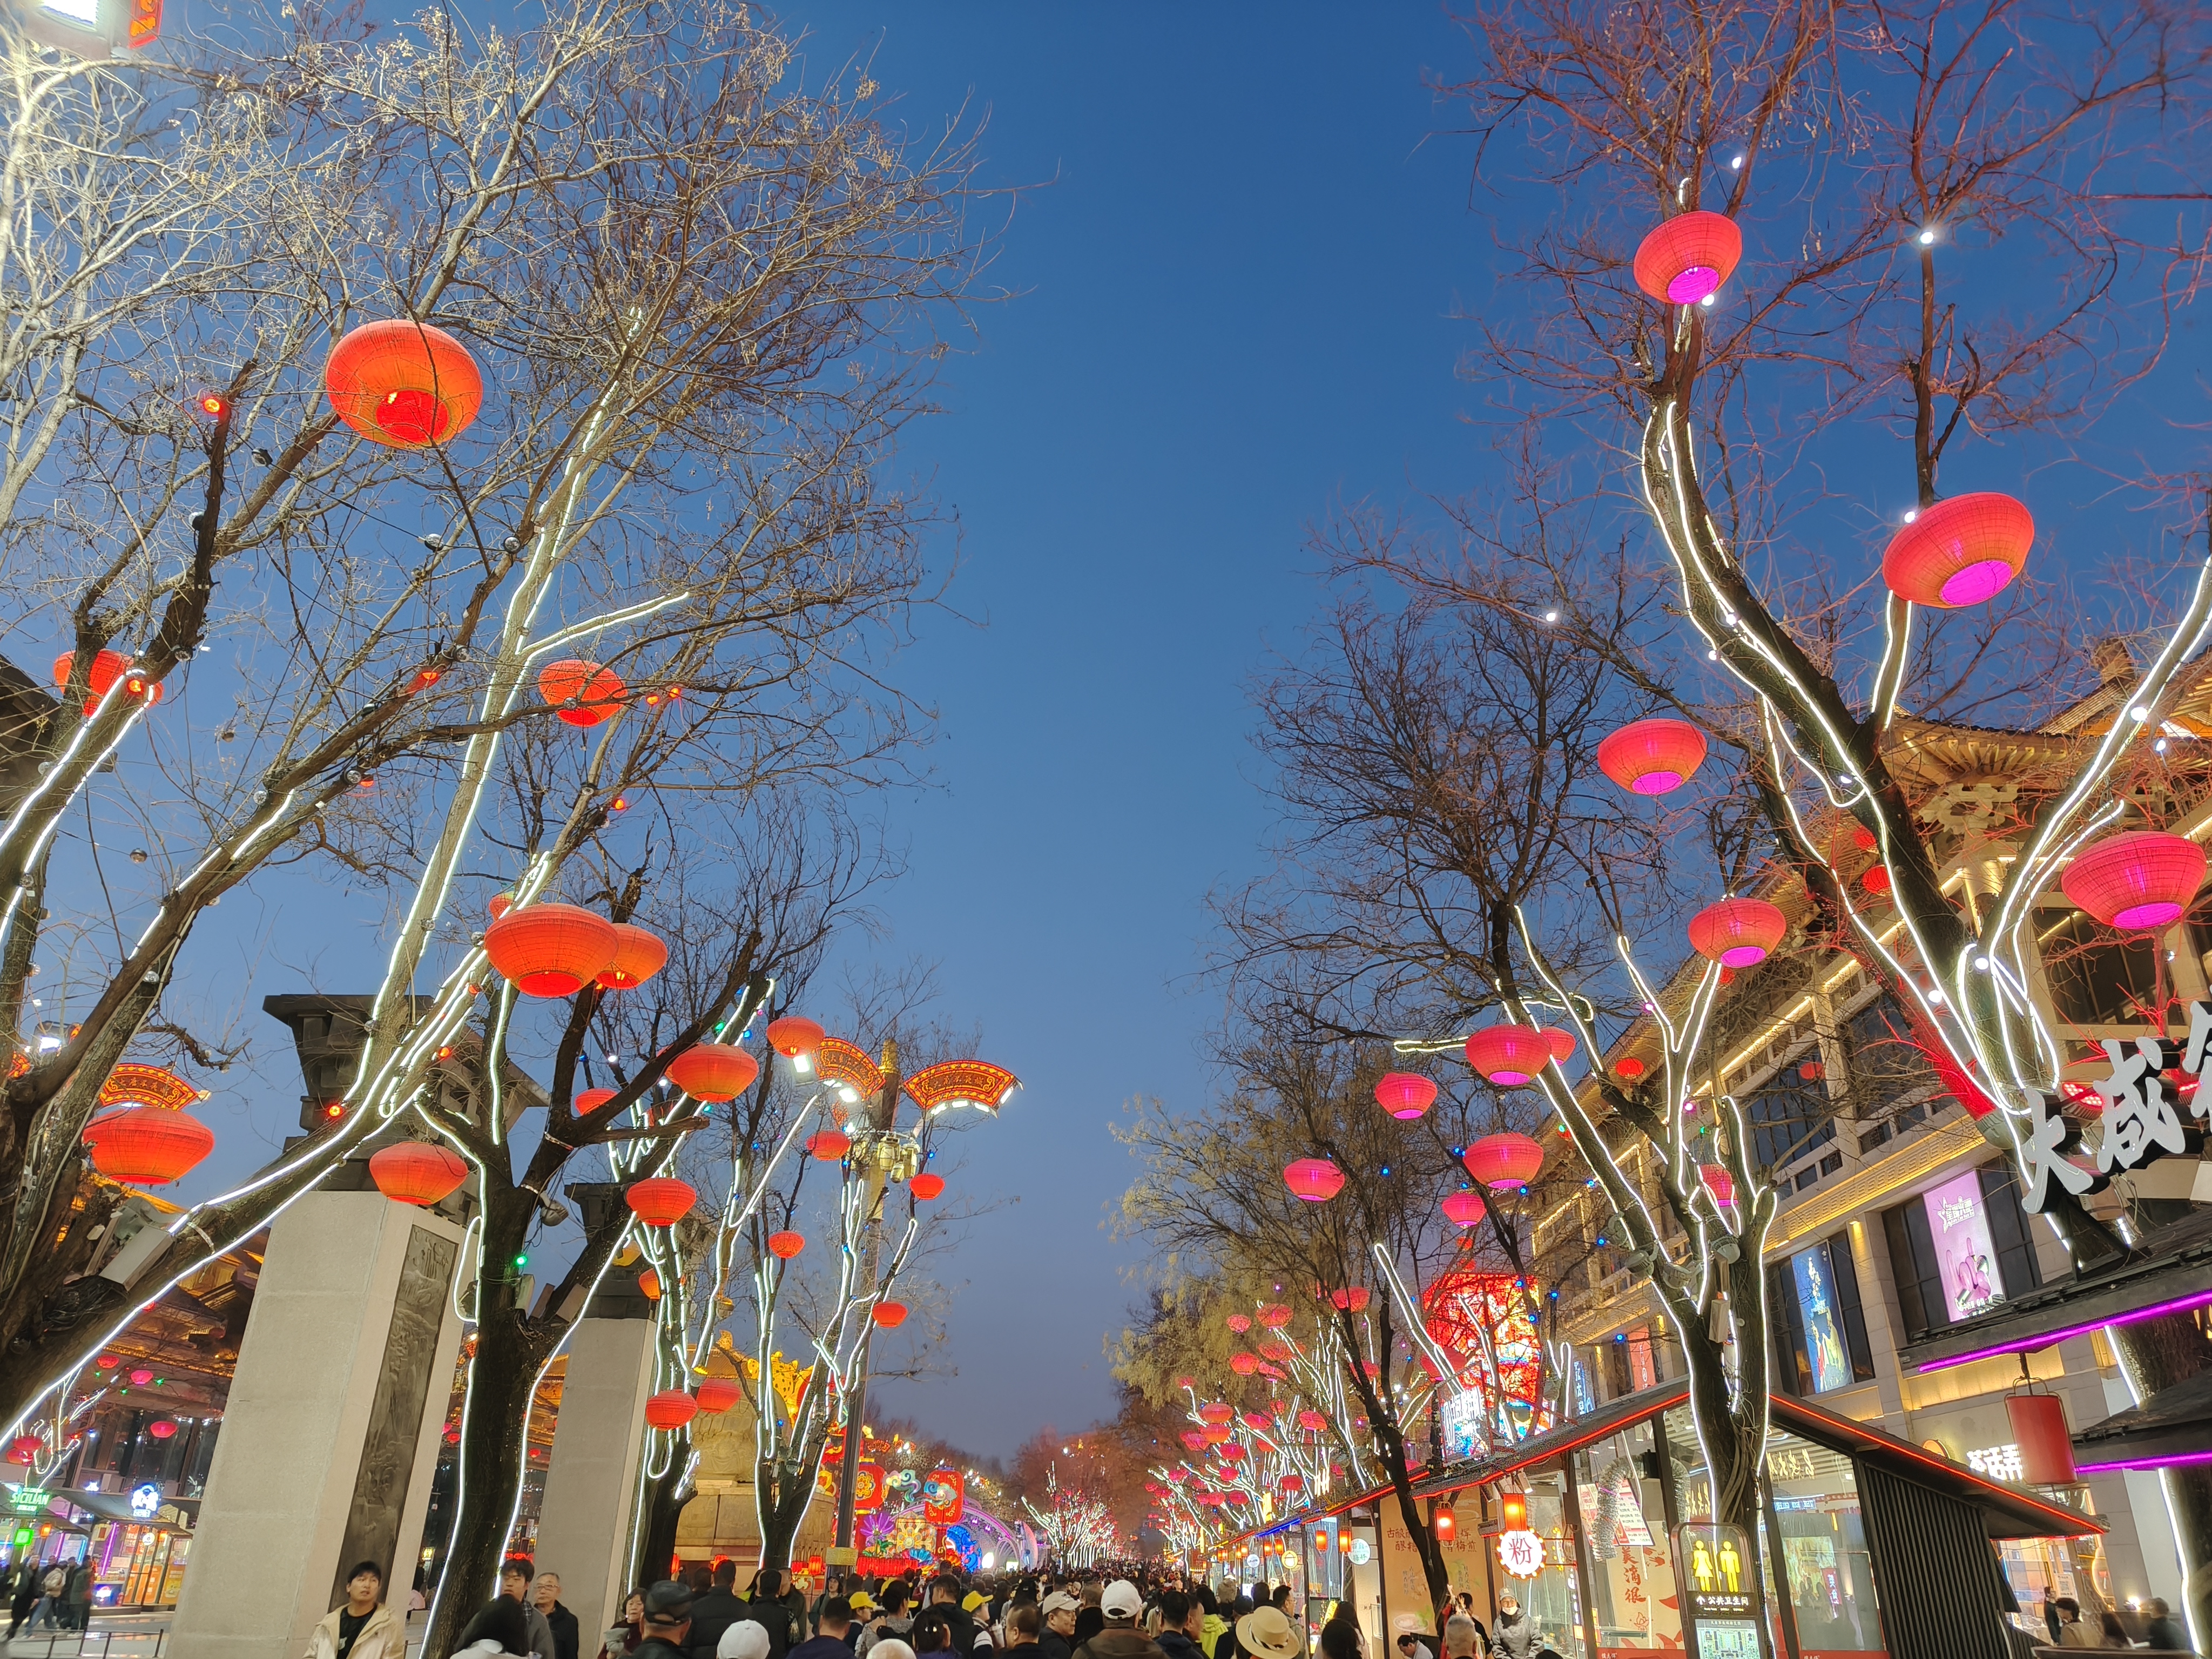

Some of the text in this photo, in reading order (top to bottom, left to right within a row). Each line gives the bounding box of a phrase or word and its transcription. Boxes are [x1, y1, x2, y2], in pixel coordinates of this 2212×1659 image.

[10, 1492, 50, 1505] SICILIAN
[1508, 1537, 1533, 1565] 粉
[1708, 1595, 1749, 1606] 公共卫生间
